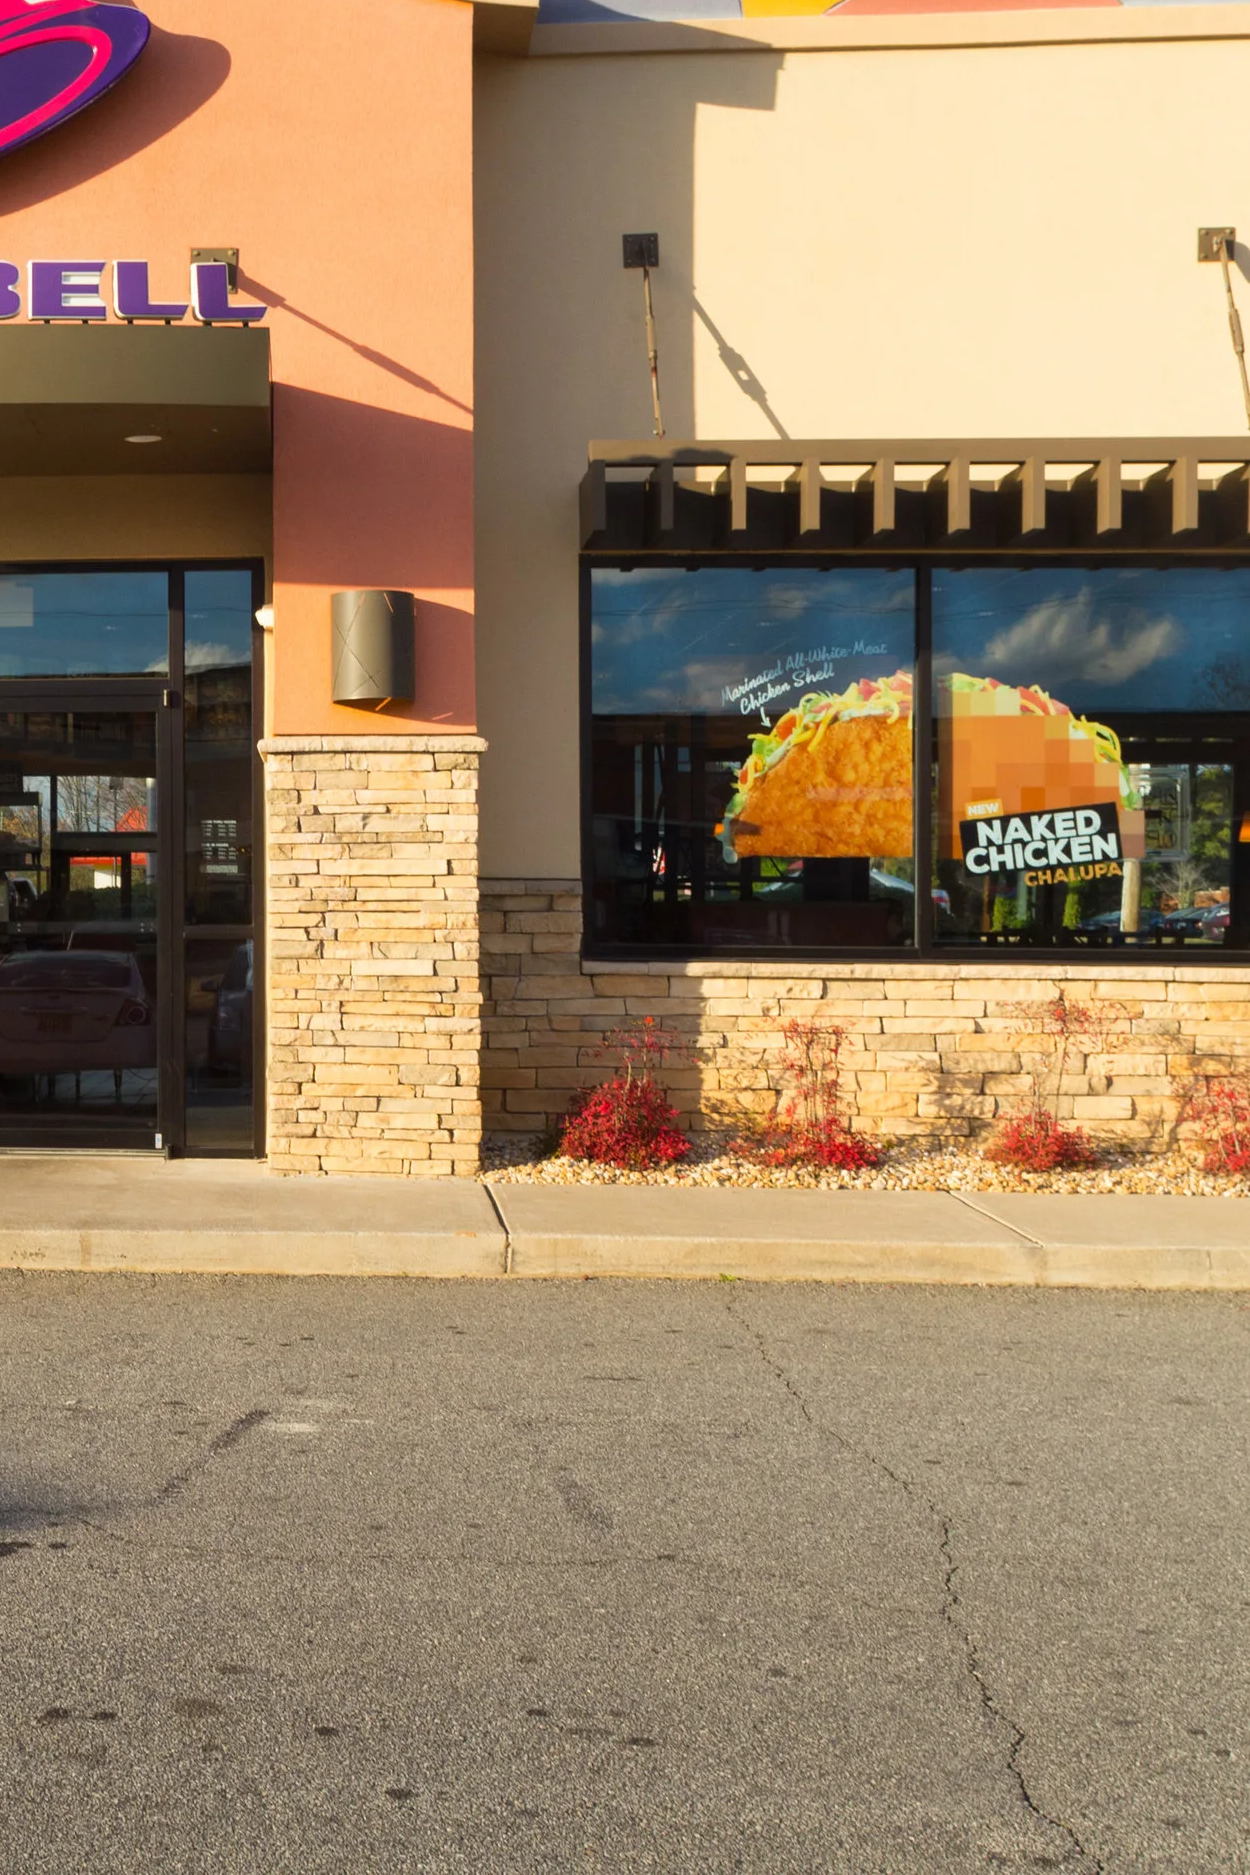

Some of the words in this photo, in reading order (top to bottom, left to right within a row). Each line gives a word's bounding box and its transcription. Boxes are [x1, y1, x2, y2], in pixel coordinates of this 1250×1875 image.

[721, 659, 784, 707] Marinated
[740, 682, 791, 715] Chicken
[792, 662, 835, 688] Shell
[967, 802, 1000, 816] NEW
[976, 809, 1102, 847] NAKED
[965, 832, 1119, 874] CHICKEN
[1024, 861, 1123, 887] CHALUPA
